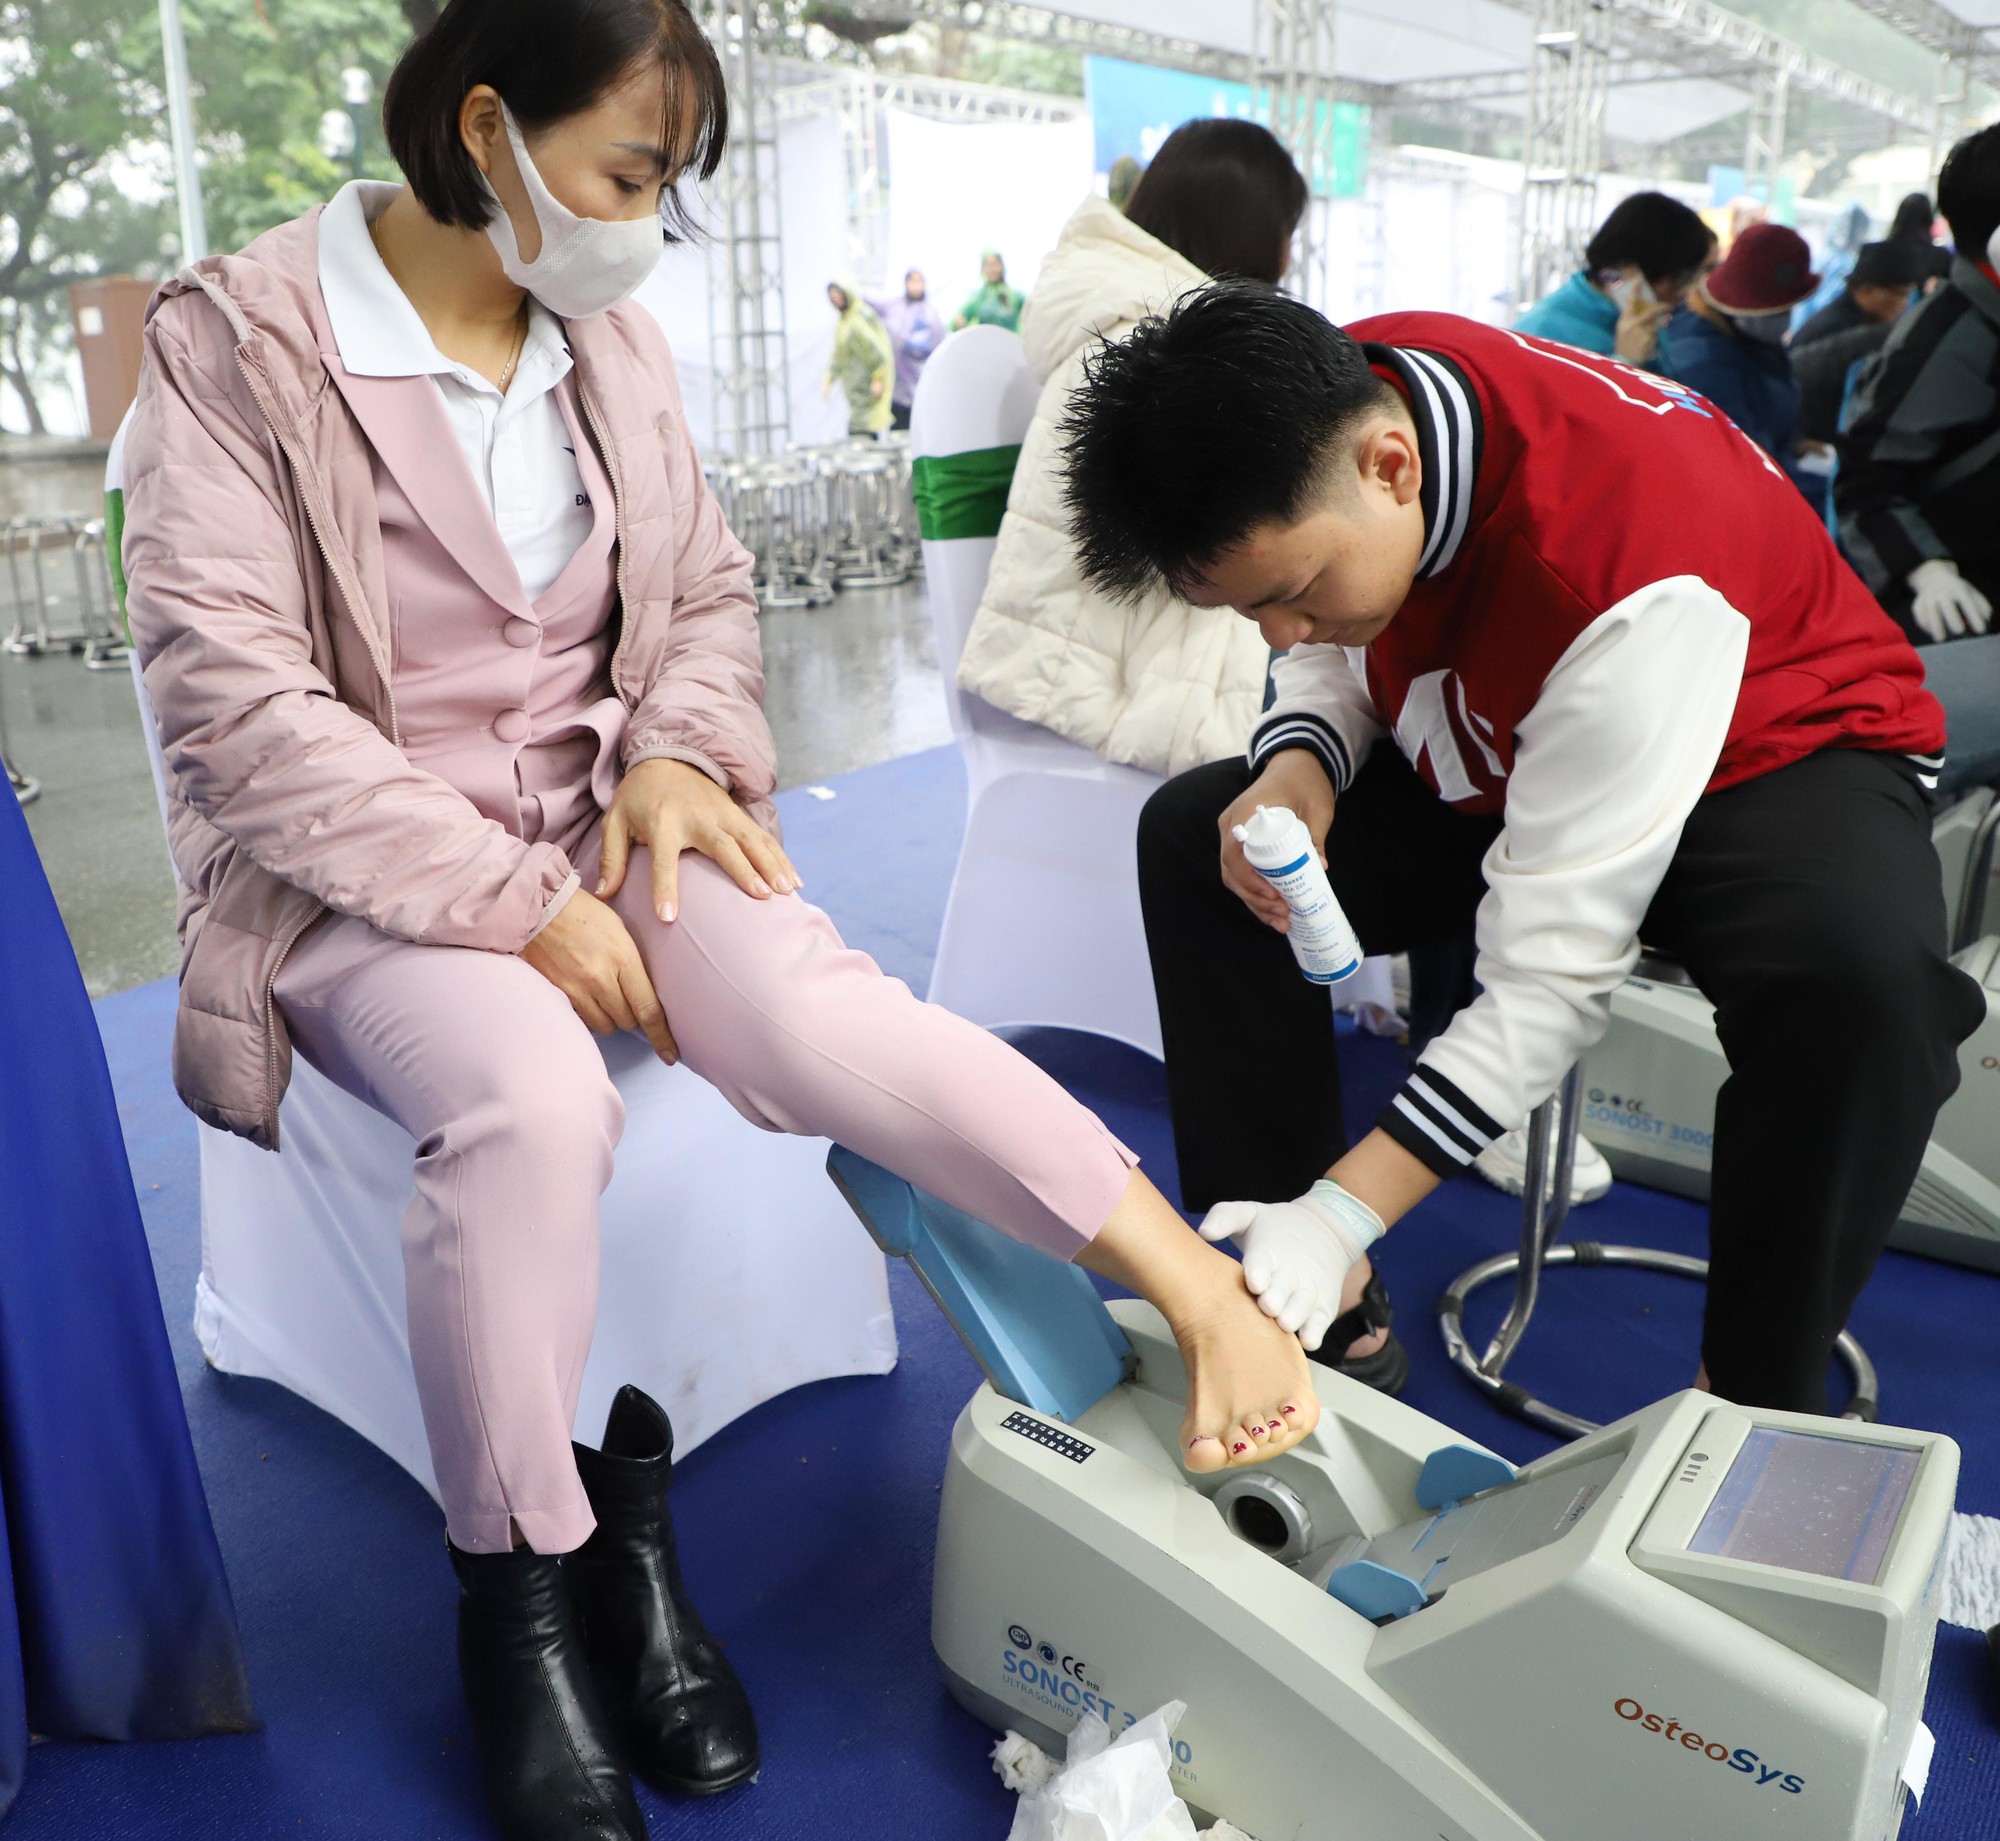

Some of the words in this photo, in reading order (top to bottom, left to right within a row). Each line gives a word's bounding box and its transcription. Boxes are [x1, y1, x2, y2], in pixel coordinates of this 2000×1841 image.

[1585, 1103, 1666, 1136] SONOST
[1062, 1655, 1086, 1682] CE
[1002, 1673, 1074, 1718] ULTRASOUND
[1003, 1649, 1116, 1724] SONOST
[1123, 1711, 1193, 1765] 30
[1614, 1697, 1806, 1794] OsteoSys
